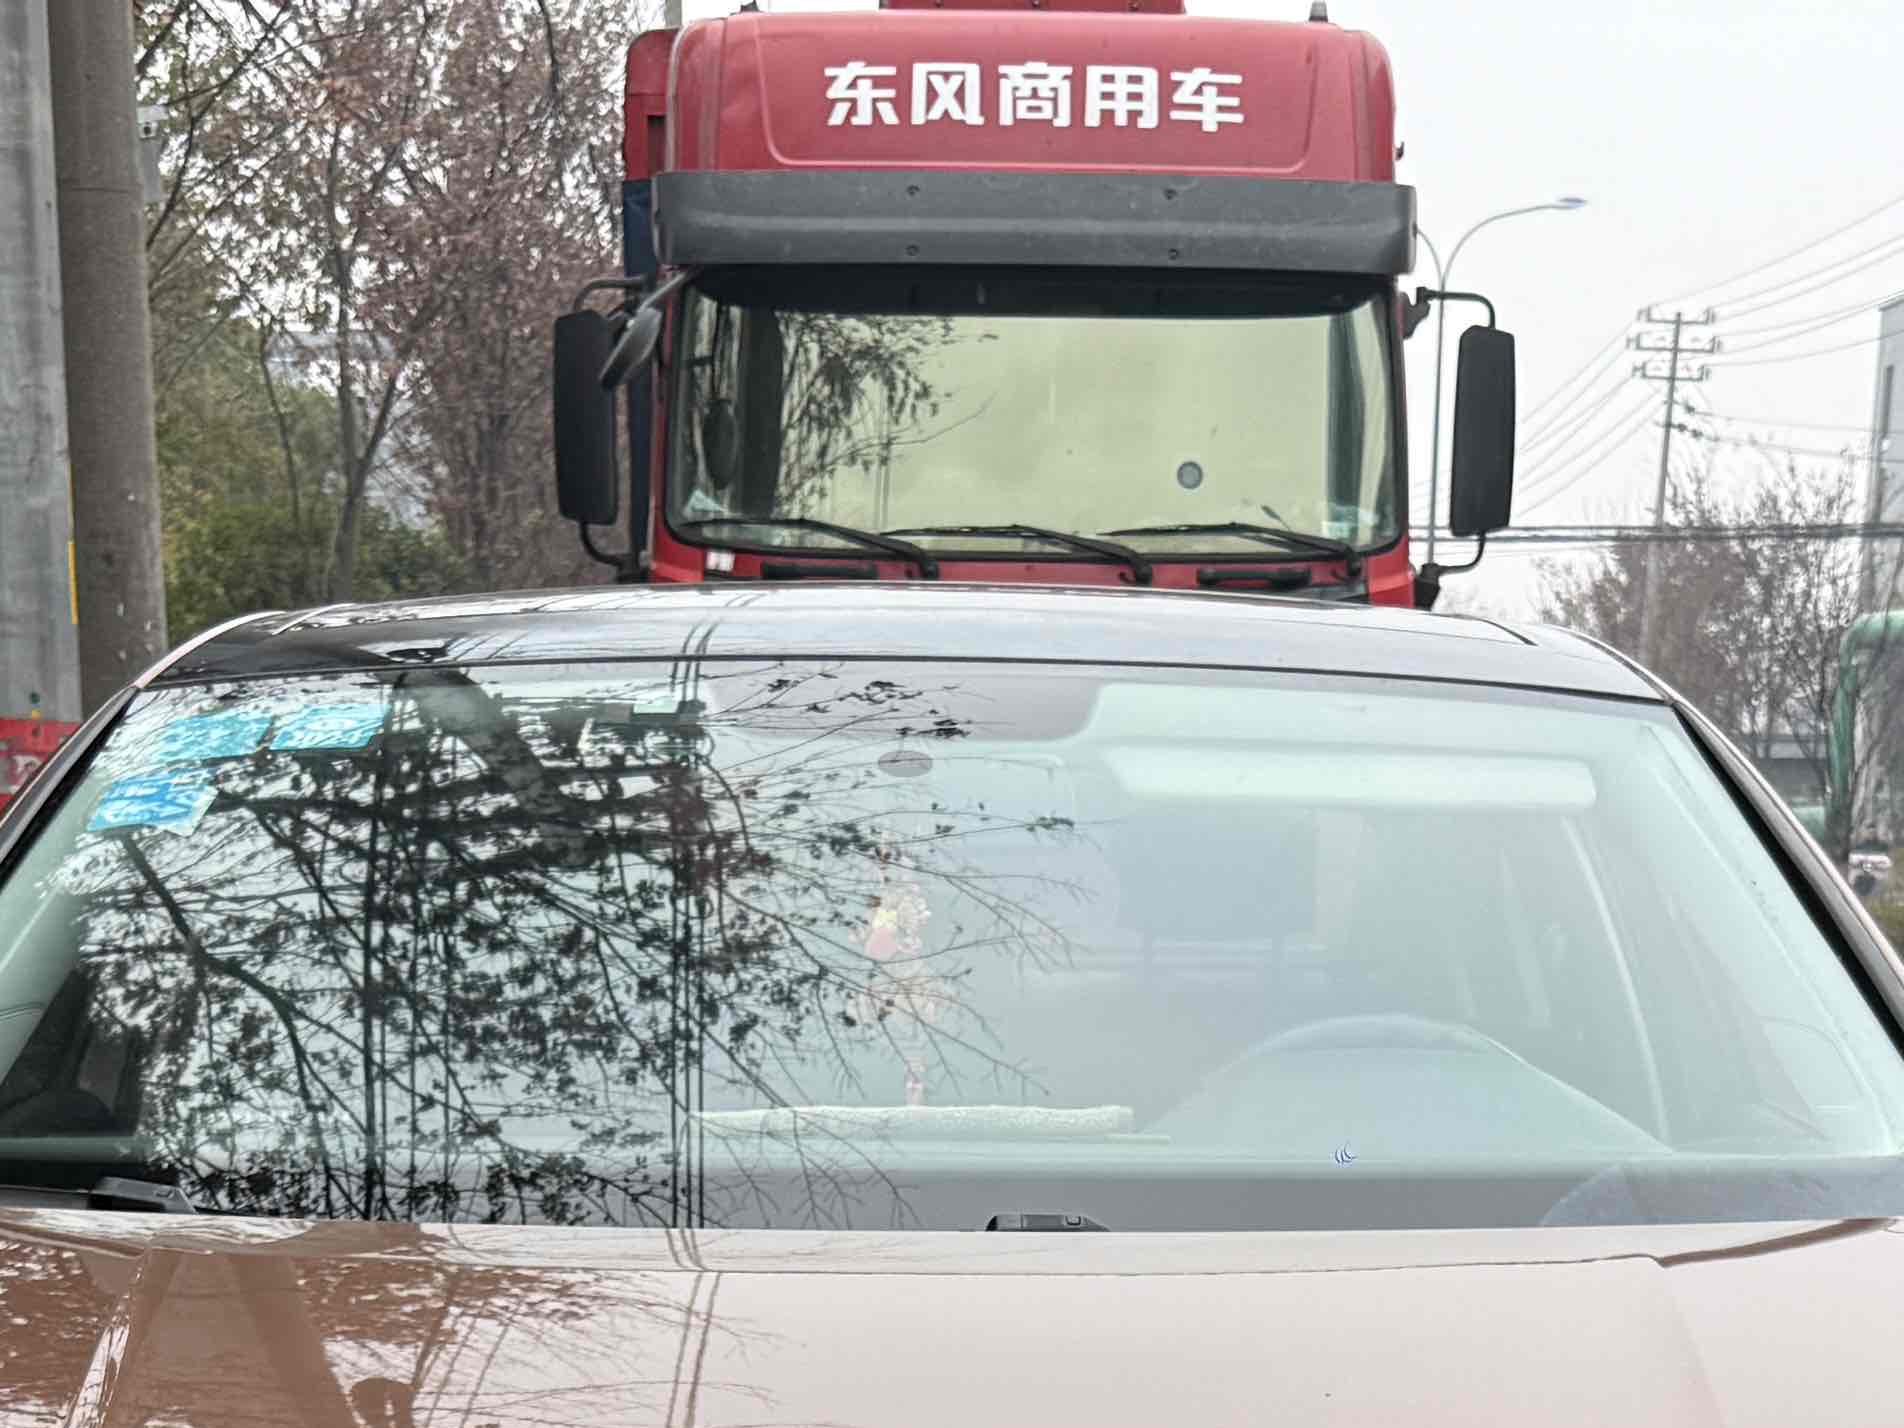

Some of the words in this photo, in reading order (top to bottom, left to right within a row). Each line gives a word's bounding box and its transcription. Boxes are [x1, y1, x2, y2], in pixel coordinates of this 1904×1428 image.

[823, 60, 1245, 133] 东风商用车
